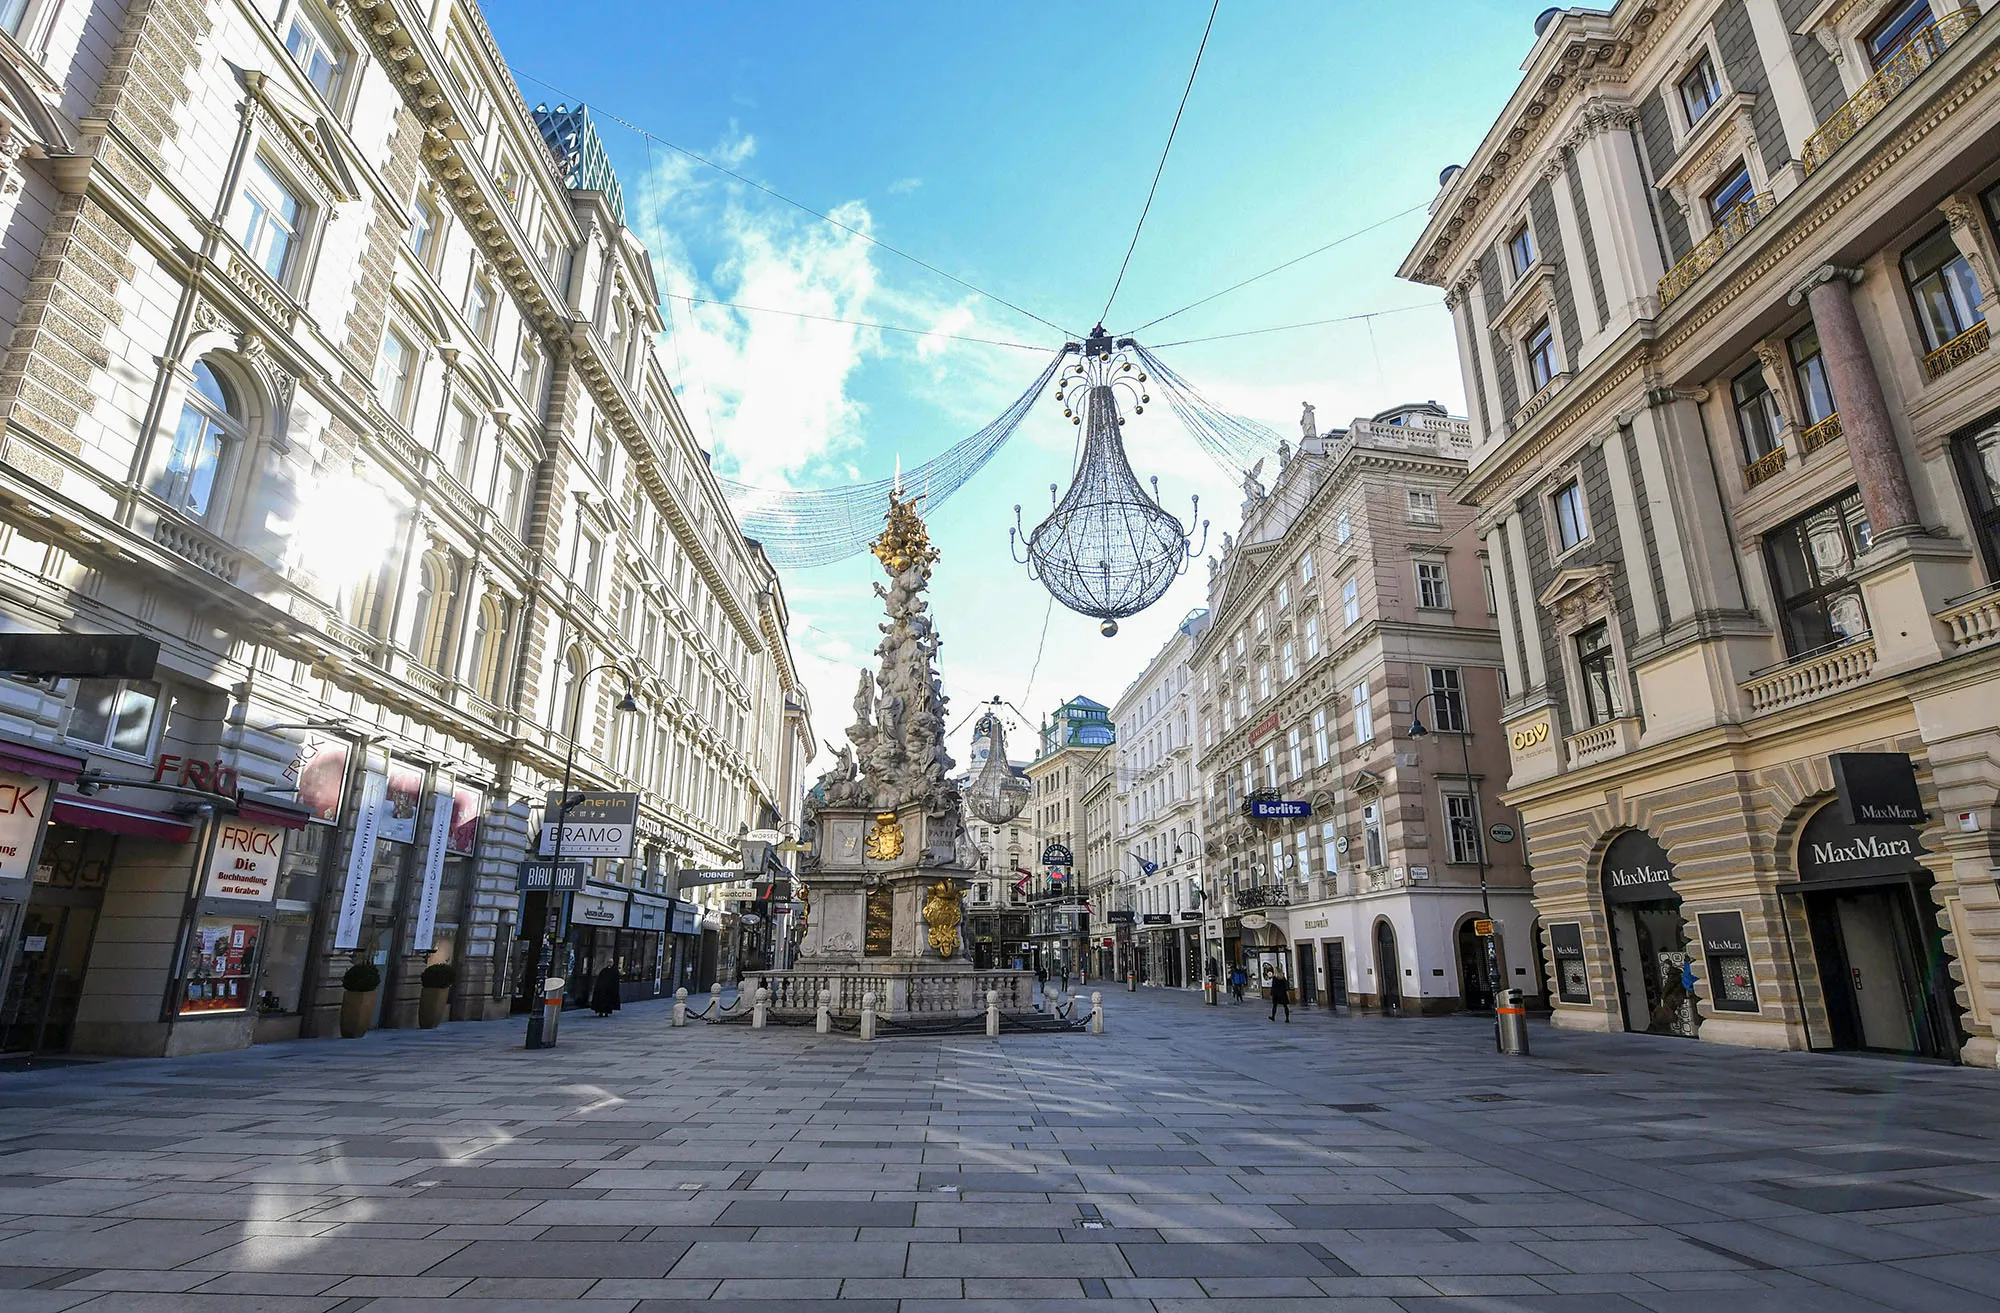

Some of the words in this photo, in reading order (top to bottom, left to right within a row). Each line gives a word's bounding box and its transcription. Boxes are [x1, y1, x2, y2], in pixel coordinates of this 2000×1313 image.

[1259, 804, 1301, 814] Berlitz
[1861, 805, 1918, 819] MaxMara
[549, 827, 622, 842] BRAMO
[1812, 836, 1911, 865] MaxMara
[235, 858, 256, 871] Die
[218, 872, 268, 886] Buchhandlung
[1611, 866, 1670, 887] MaxMara
[235, 886, 260, 896] Graben
[1709, 941, 1742, 950] MaxMara
